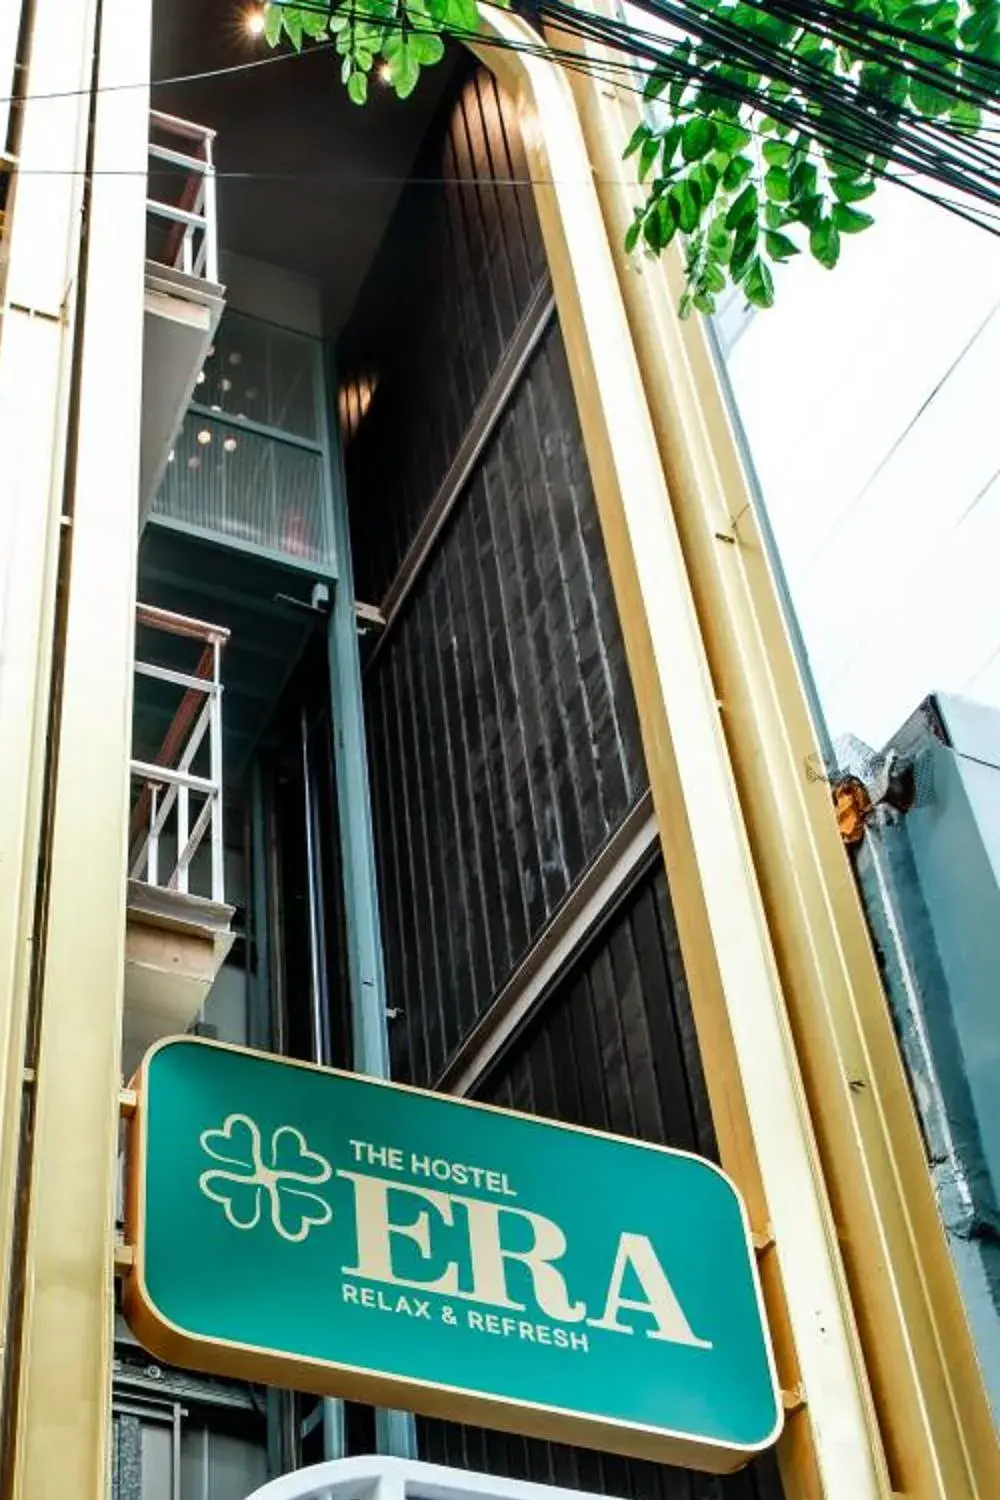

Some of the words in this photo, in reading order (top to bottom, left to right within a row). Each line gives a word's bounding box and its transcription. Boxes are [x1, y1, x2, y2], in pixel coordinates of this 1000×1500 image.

[349, 1138, 404, 1171] THE
[411, 1152, 518, 1197] HOSTEL
[336, 1169, 712, 1350] ERA
[342, 1283, 432, 1320] RELAX
[441, 1305, 458, 1326] &
[467, 1310, 590, 1353] REFRESH
